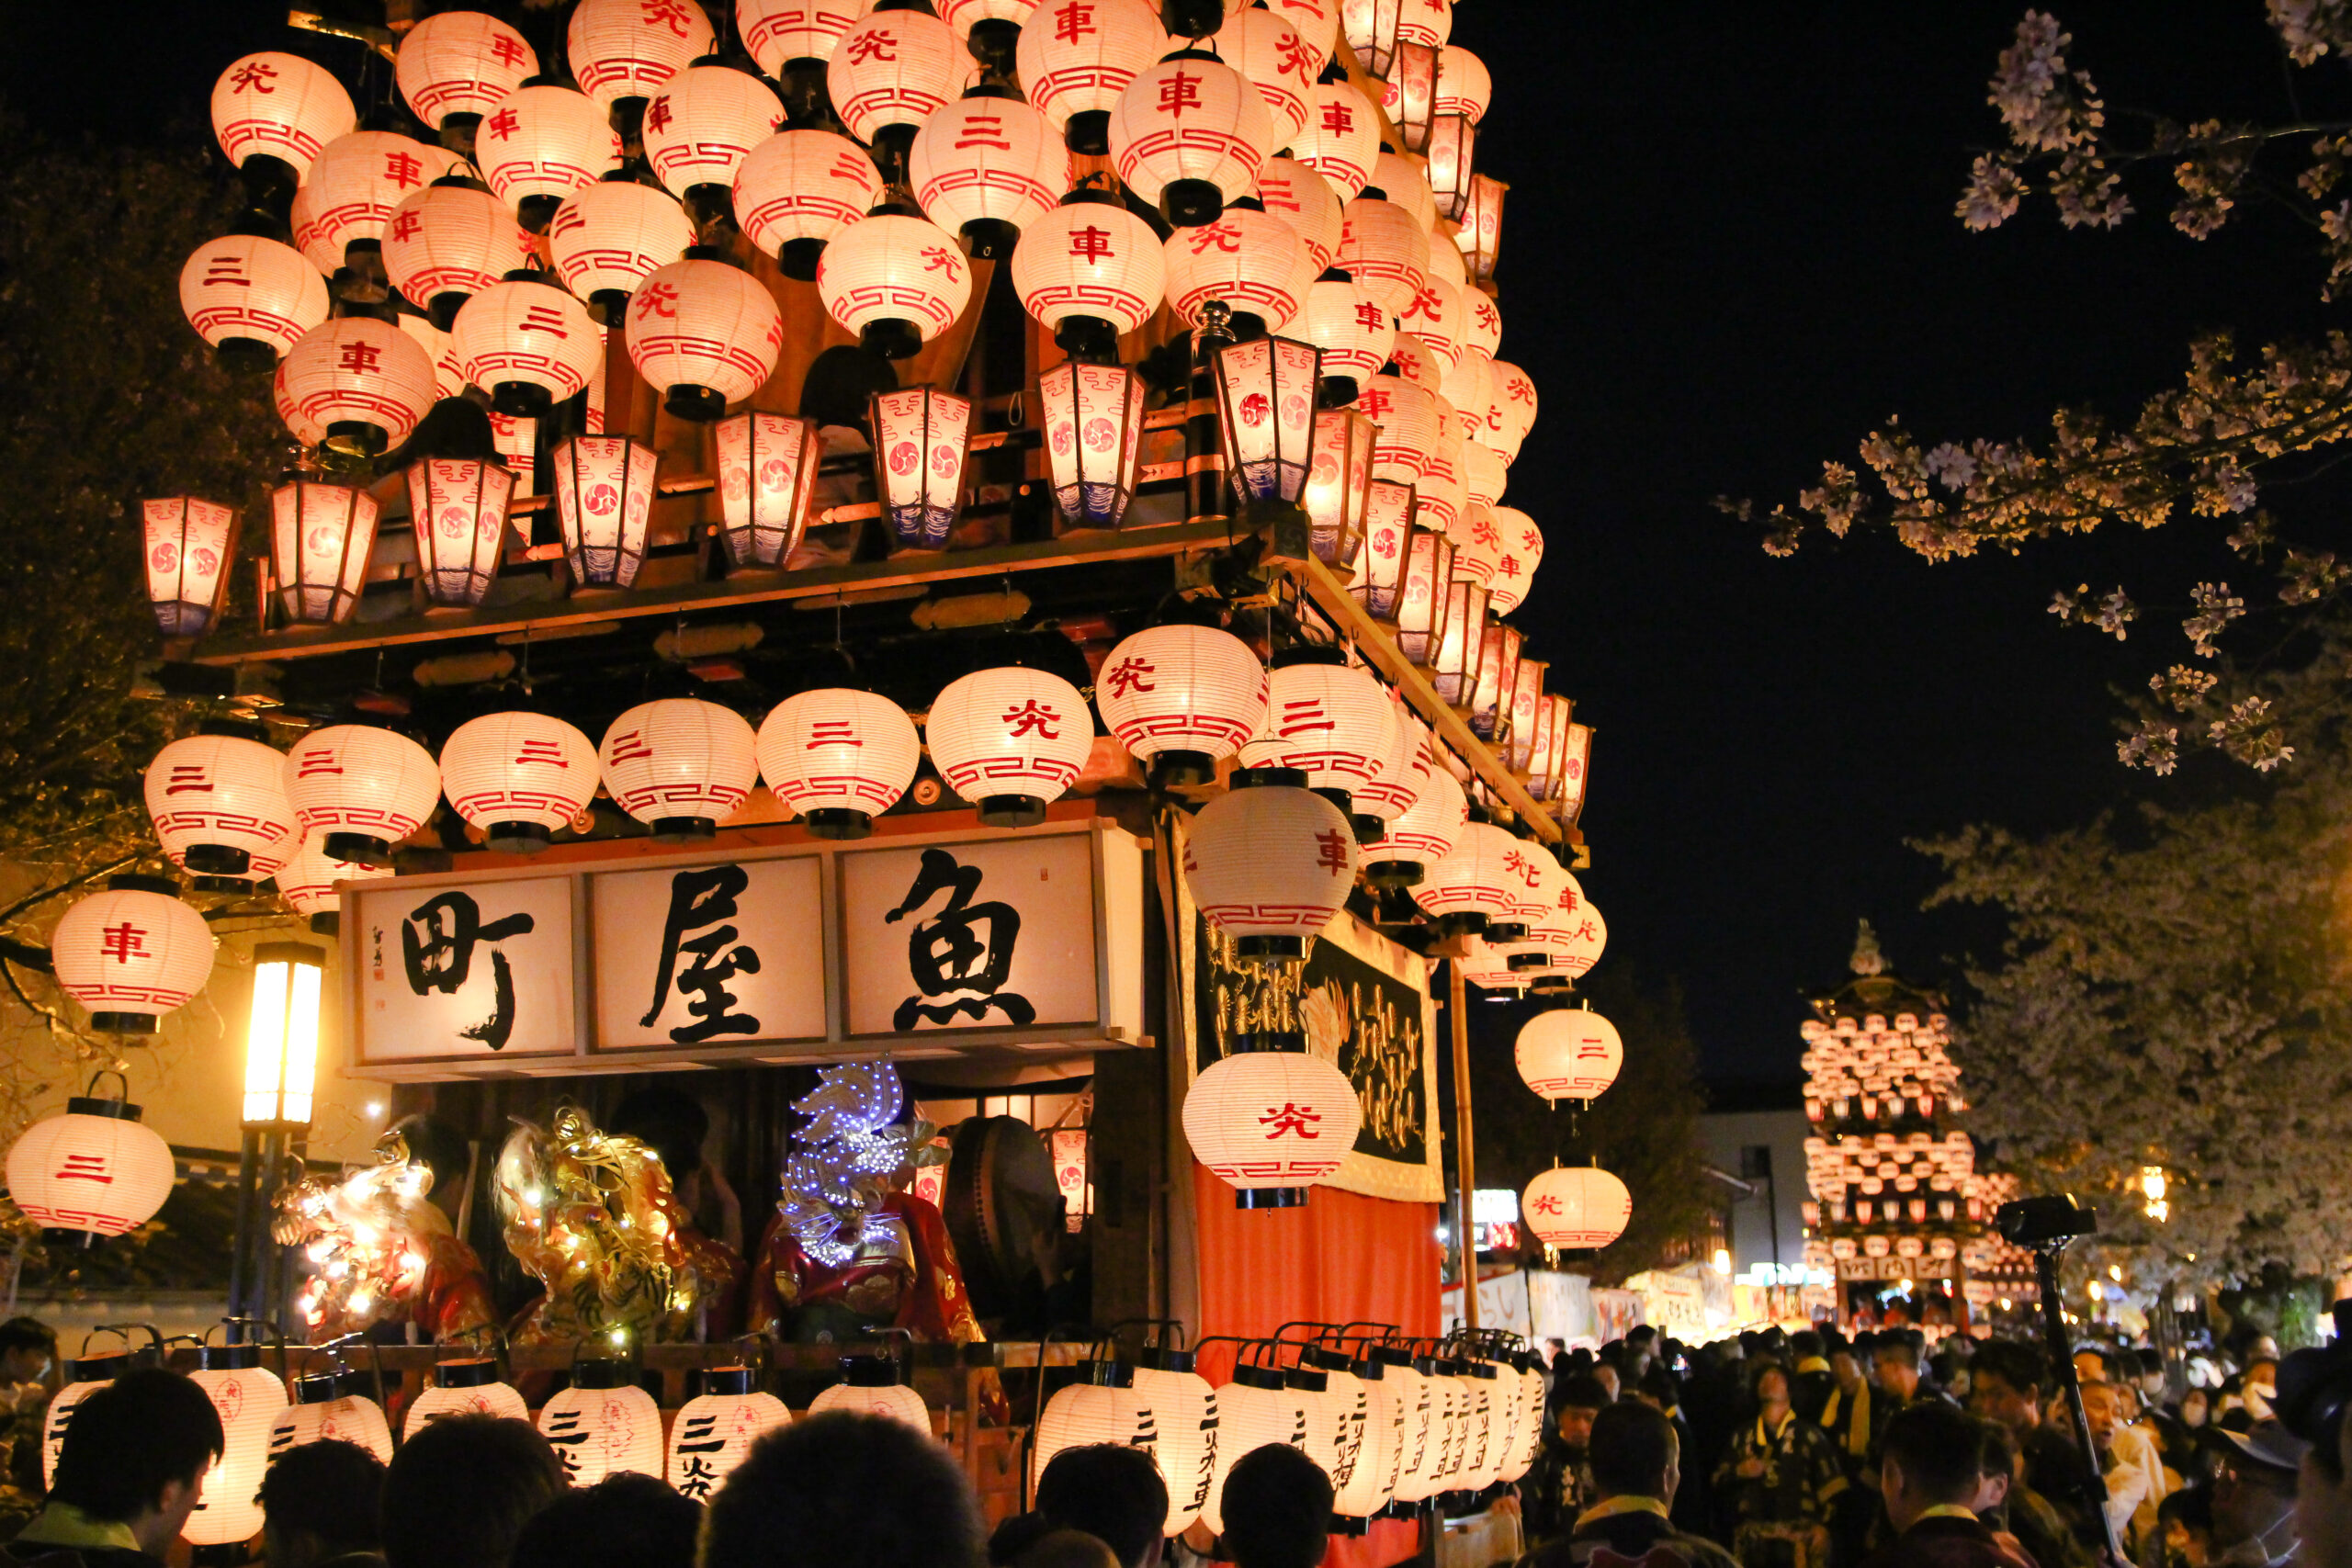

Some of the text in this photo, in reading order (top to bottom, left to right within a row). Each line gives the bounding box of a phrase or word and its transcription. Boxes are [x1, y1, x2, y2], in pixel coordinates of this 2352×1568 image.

[1055, 1, 1096, 46] 車
[492, 33, 526, 68] 車
[1157, 72, 1204, 118] 車
[488, 107, 520, 141] 車
[649, 95, 673, 135] 車
[1319, 101, 1354, 138] 車
[956, 116, 1010, 150] 三
[384, 152, 423, 188] 車
[830, 152, 871, 192] 三
[392, 209, 423, 243] 車
[555, 204, 584, 239] 三
[1069, 225, 1114, 265] 車
[203, 257, 250, 287] 三
[519, 306, 568, 339] 三
[1355, 301, 1385, 333] 車
[339, 341, 380, 374] 車
[1358, 389, 1394, 420] 車
[1498, 555, 1521, 579] 車
[1280, 698, 1334, 737] 三
[610, 730, 652, 766] 三
[806, 722, 863, 750] 三
[299, 750, 343, 778] 三
[515, 740, 569, 768] 三
[166, 767, 213, 795] 三
[1316, 829, 1348, 876] 車
[1558, 886, 1577, 915] 車
[101, 922, 151, 964] 車
[402, 848, 1037, 1052] 魚屋町
[1577, 1038, 1609, 1060] 三
[56, 1155, 112, 1184] 三
